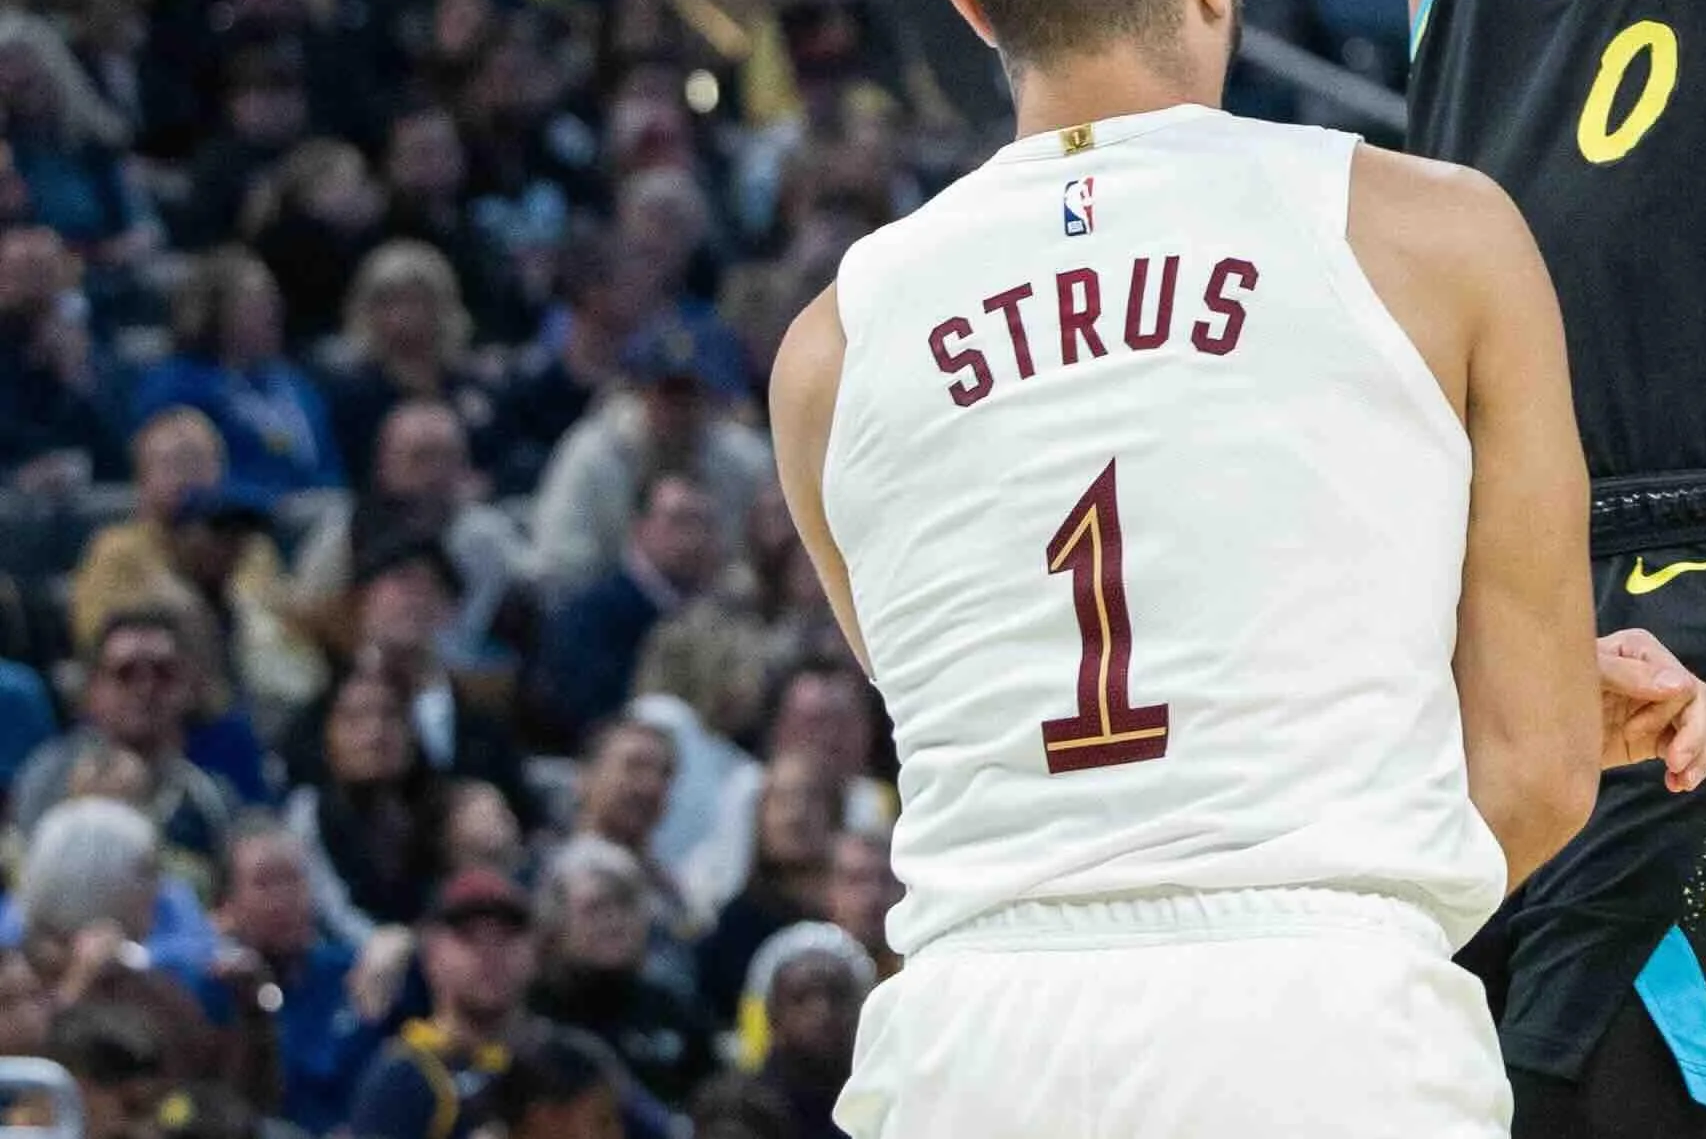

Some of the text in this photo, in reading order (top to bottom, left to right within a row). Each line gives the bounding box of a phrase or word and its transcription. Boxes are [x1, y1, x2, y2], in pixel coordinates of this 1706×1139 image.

[1577, 20, 1678, 164] 0
[927, 254, 1259, 407] STRUS
[1041, 456, 1169, 774] 1
